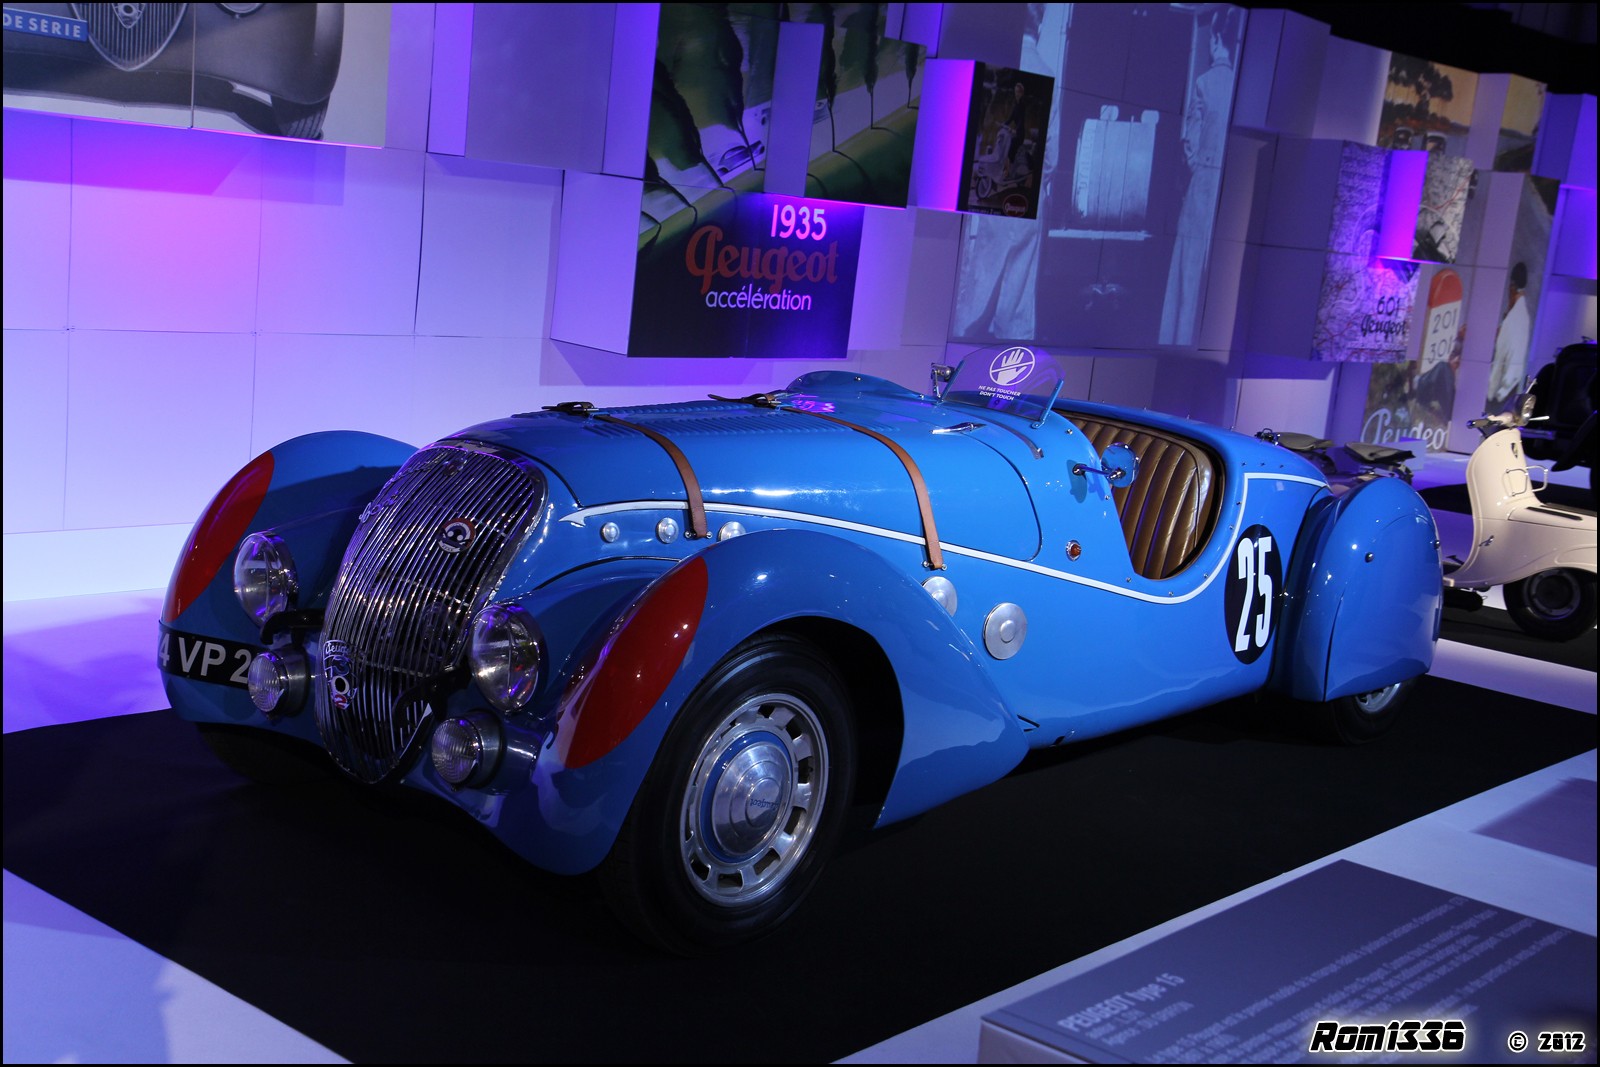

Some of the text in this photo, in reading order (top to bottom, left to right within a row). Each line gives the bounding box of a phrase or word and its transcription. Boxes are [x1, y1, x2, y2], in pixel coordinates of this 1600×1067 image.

[770, 203, 827, 241] 1935
[685, 224, 839, 295] Peugeot
[705, 283, 812, 311] accélération
[1376, 296, 1400, 317] 601
[1360, 314, 1407, 339] Peugeot
[1432, 308, 1458, 334] 201
[1427, 335, 1453, 364] 301
[996, 388, 1021, 397] TOUCHER
[996, 393, 1015, 401] TOUCH
[1234, 535, 1273, 653] 25
[178, 637, 226, 677] VP
[1056, 994, 1136, 1033] PEUGEOT
[1124, 983, 1167, 1002] type
[1155, 972, 1185, 987] 15
